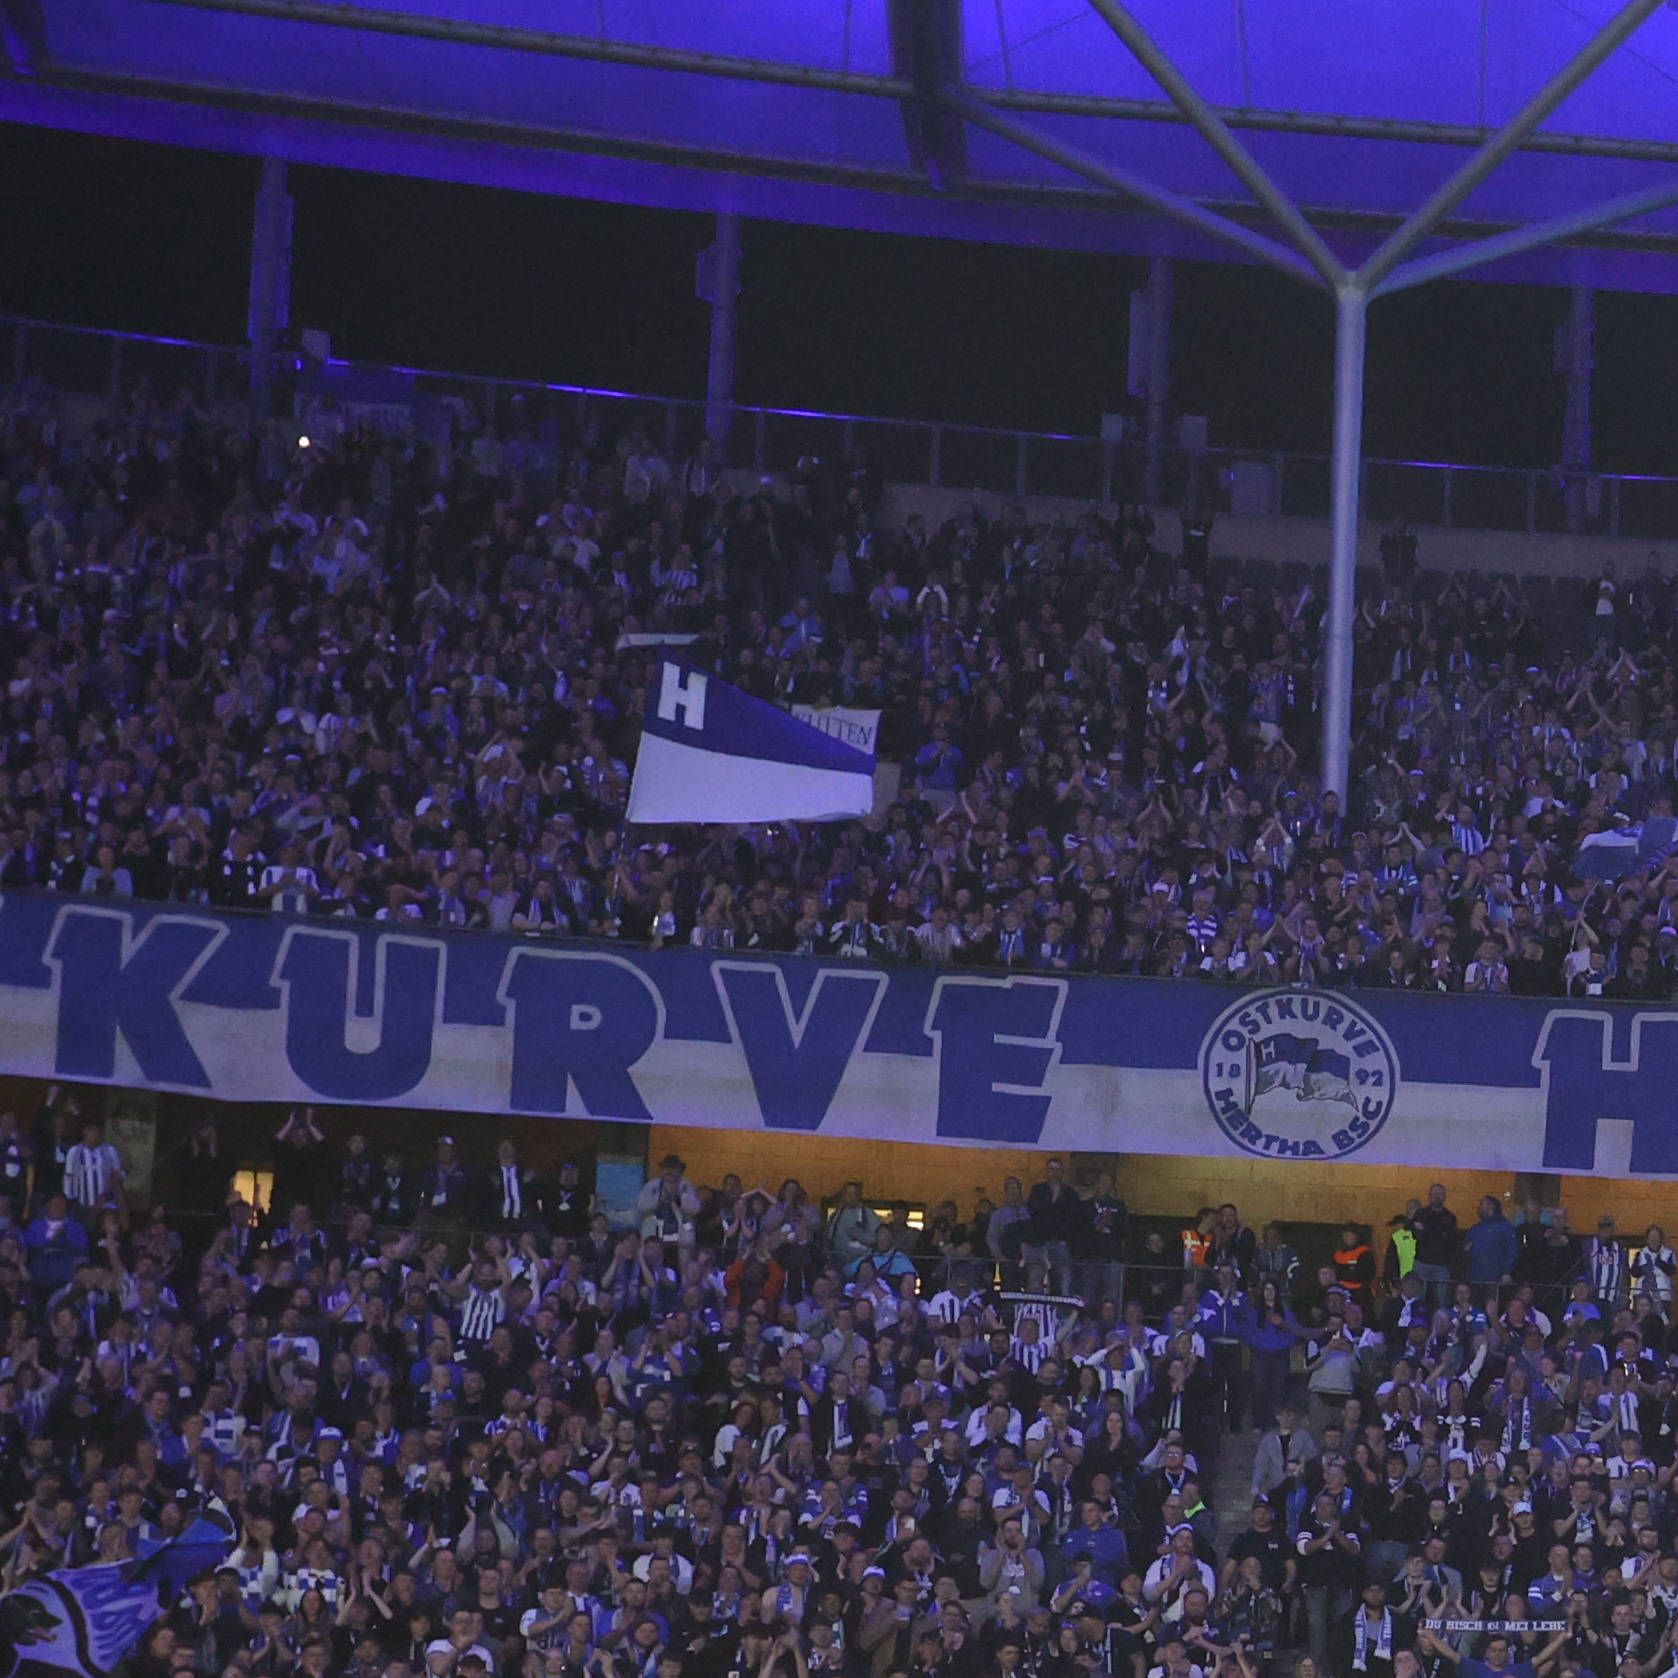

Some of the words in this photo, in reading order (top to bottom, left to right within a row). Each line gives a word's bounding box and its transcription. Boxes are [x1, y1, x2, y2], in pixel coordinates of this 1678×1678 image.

[657, 661, 708, 730] H
[43, 902, 1070, 1146] KURVE
[1221, 997, 1381, 1058] OSTKURVE
[1355, 1067, 1385, 1088] 92
[1214, 1087, 1326, 1157] HERTHA
[1331, 1096, 1384, 1151] BSC
